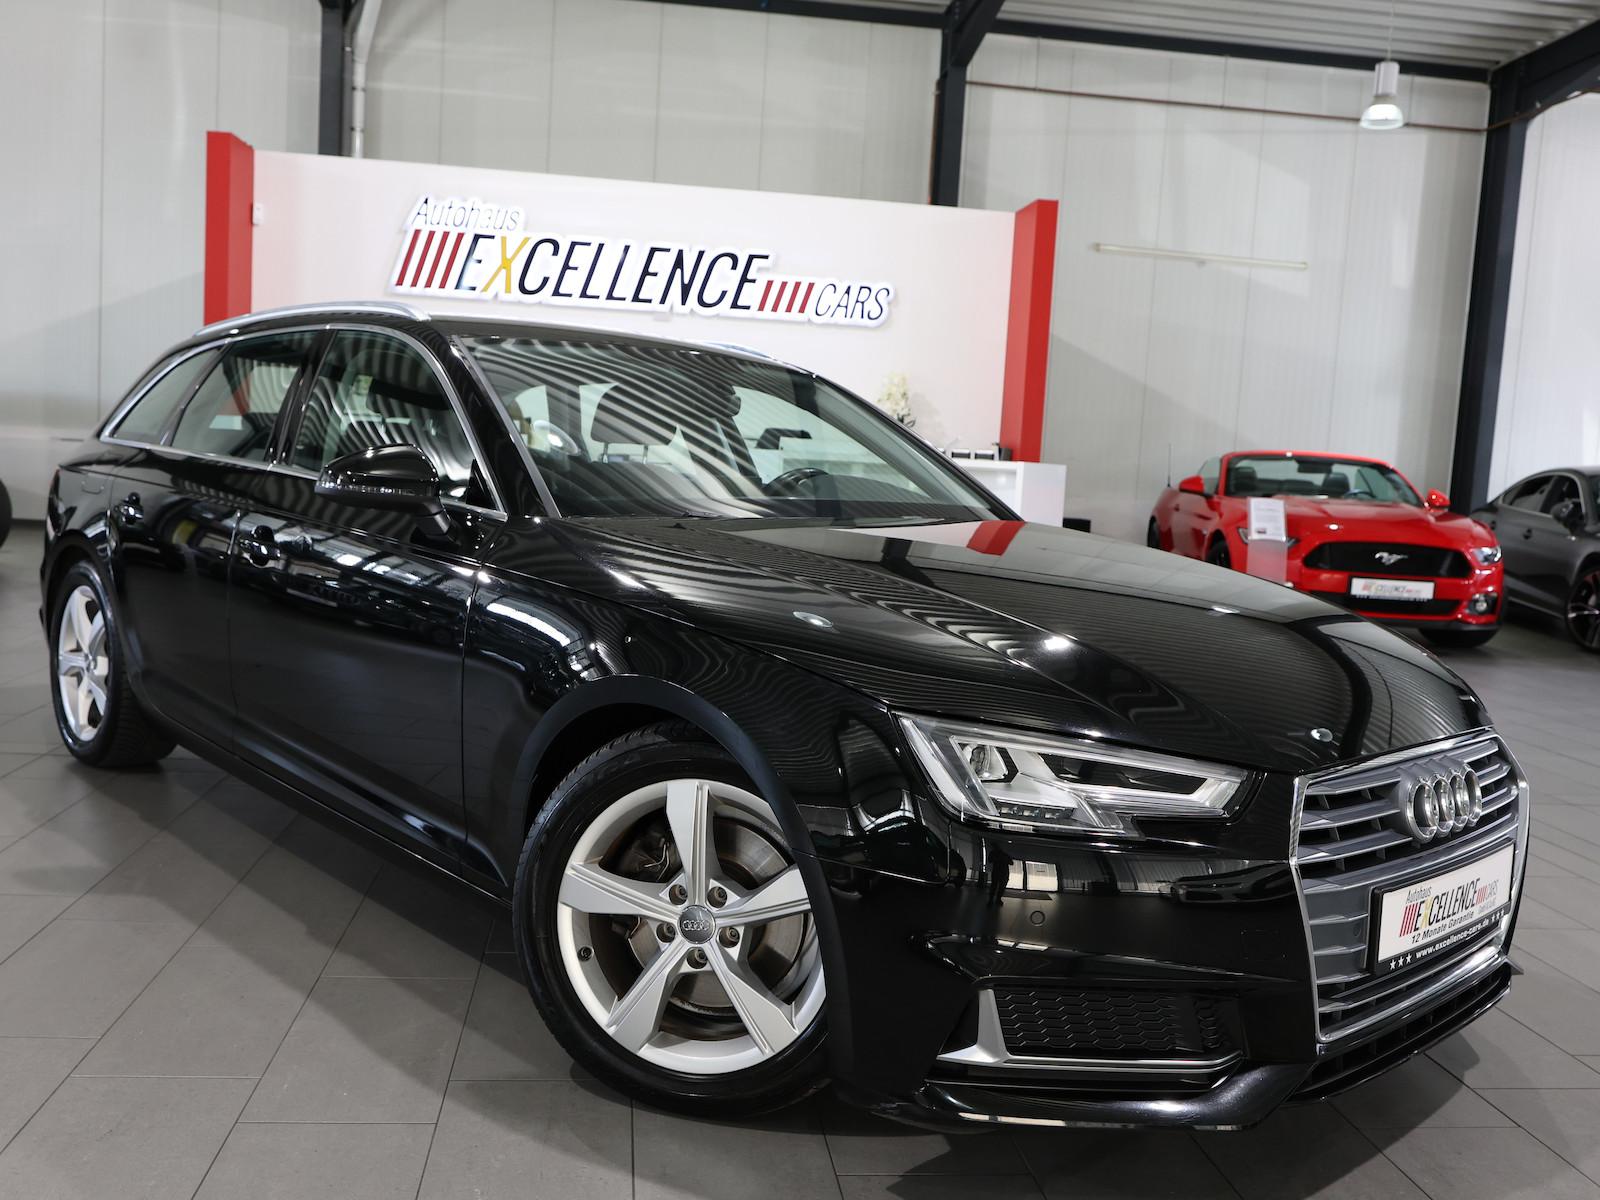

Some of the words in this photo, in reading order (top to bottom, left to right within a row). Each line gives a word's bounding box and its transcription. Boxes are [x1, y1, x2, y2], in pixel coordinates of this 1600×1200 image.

[413, 197, 520, 230] Autohaus
[454, 232, 770, 311] EXCELLENCE
[814, 282, 891, 321] CARS
[1406, 886, 1432, 904] Autohaus
[1414, 877, 1480, 932] EXCELLENCE
[1411, 932, 1420, 945] 12
[1422, 922, 1447, 941] Monate
[1448, 910, 1474, 929] Garantie
[1415, 919, 1489, 959] www.excellence-cars.de
